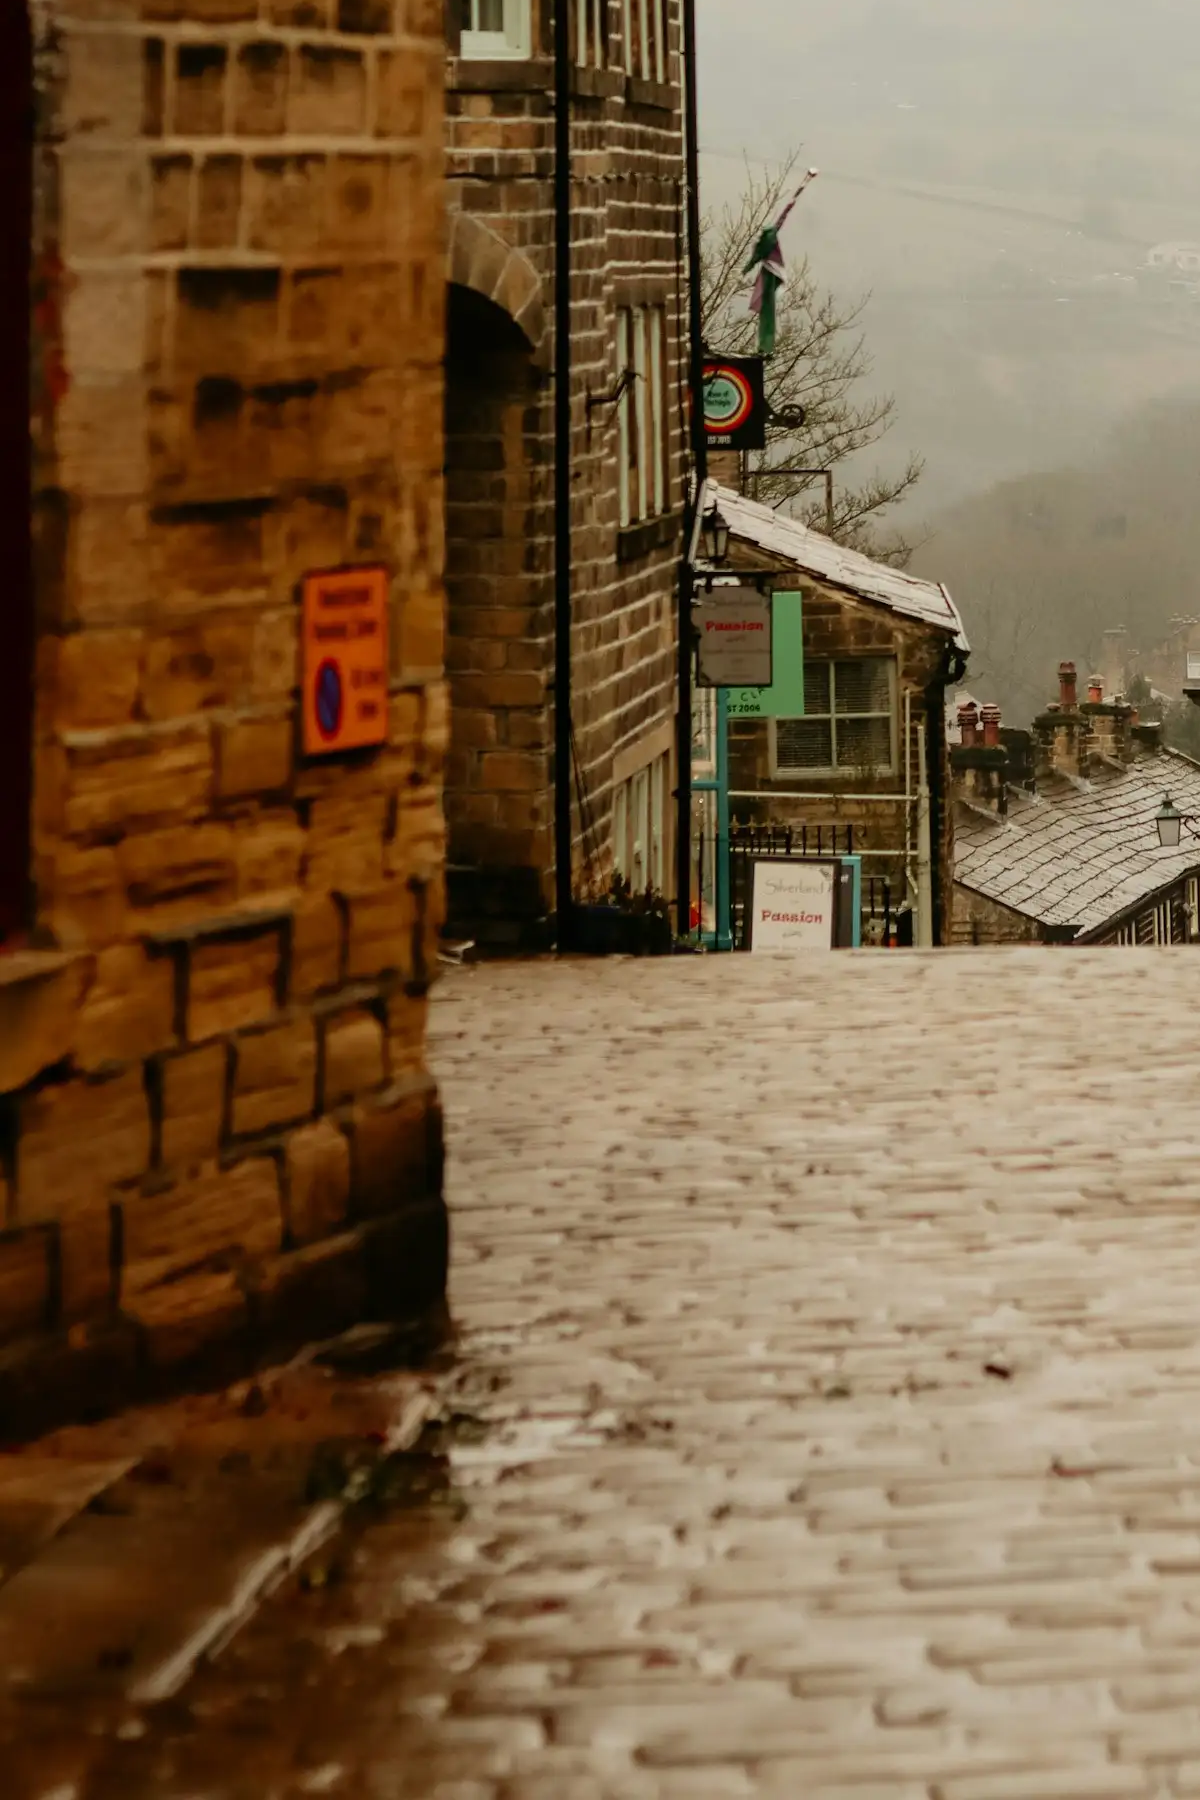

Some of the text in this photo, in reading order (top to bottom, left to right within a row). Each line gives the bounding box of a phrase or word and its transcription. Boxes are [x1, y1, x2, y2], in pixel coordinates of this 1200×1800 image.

[705, 620, 764, 632] Passion
[726, 704, 761, 713] ST 2006
[761, 909, 822, 925] Passion
